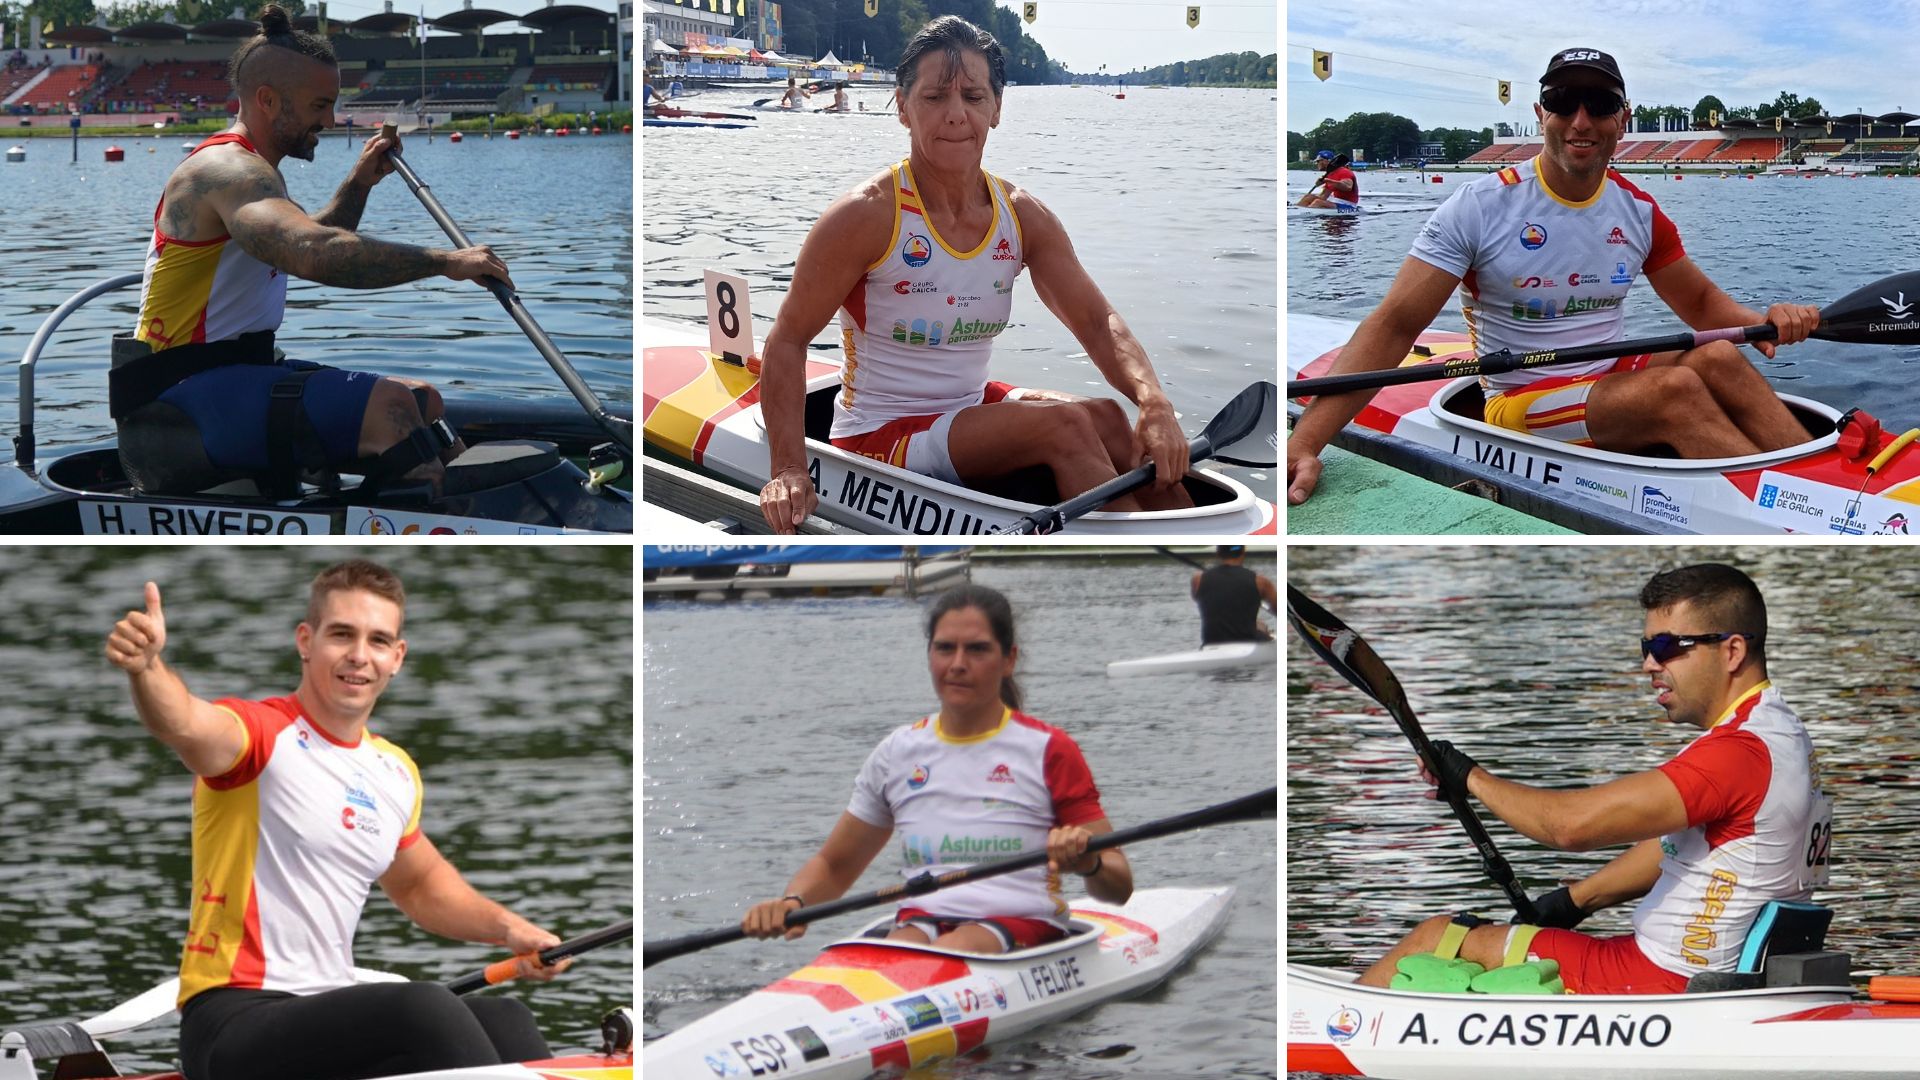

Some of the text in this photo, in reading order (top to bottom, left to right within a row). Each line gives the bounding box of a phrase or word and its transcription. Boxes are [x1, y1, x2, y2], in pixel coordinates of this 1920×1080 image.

[1026, 5, 1035, 18] 2
[1189, 8, 1198, 22] 3
[1317, 54, 1329, 72] 1
[1563, 51, 1601, 62] ESP
[1501, 83, 1509, 98] 2
[716, 280, 740, 339] 8
[1575, 476, 1629, 500] DINGONATURA
[1779, 489, 1809, 504] XUNTA
[1645, 497, 1681, 513] promesas
[1776, 498, 1824, 518] DE GALICIA
[938, 833, 1024, 854] Asturias
[1806, 822, 1830, 868] 82
[1680, 868, 1738, 967] ESPAÑA
[1029, 957, 1085, 998] FELIPE
[1398, 1013, 1672, 1048] A. CASTAÑO
[730, 1033, 787, 1077] ESP
